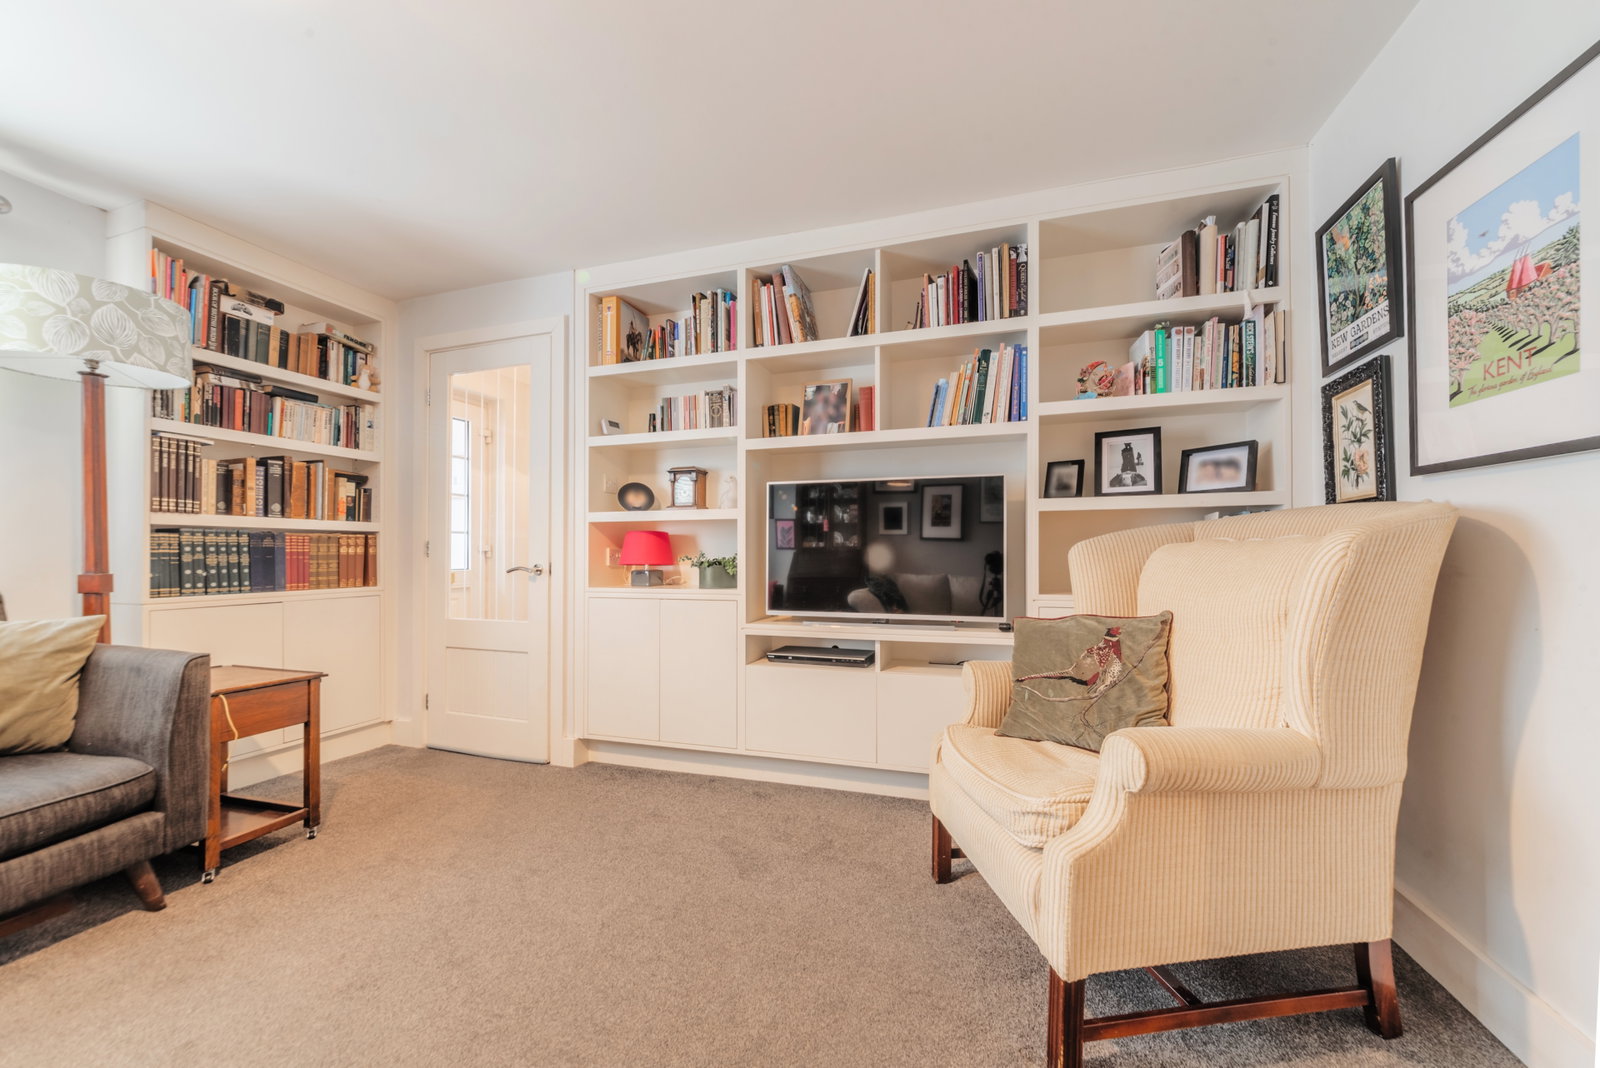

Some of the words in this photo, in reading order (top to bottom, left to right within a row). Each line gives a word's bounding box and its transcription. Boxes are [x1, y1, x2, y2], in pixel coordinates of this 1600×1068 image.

[1246, 322, 1254, 335] RICK
[1331, 330, 1348, 350] KEW
[1350, 304, 1390, 338] GARDENS
[1483, 346, 1537, 381] KENT
